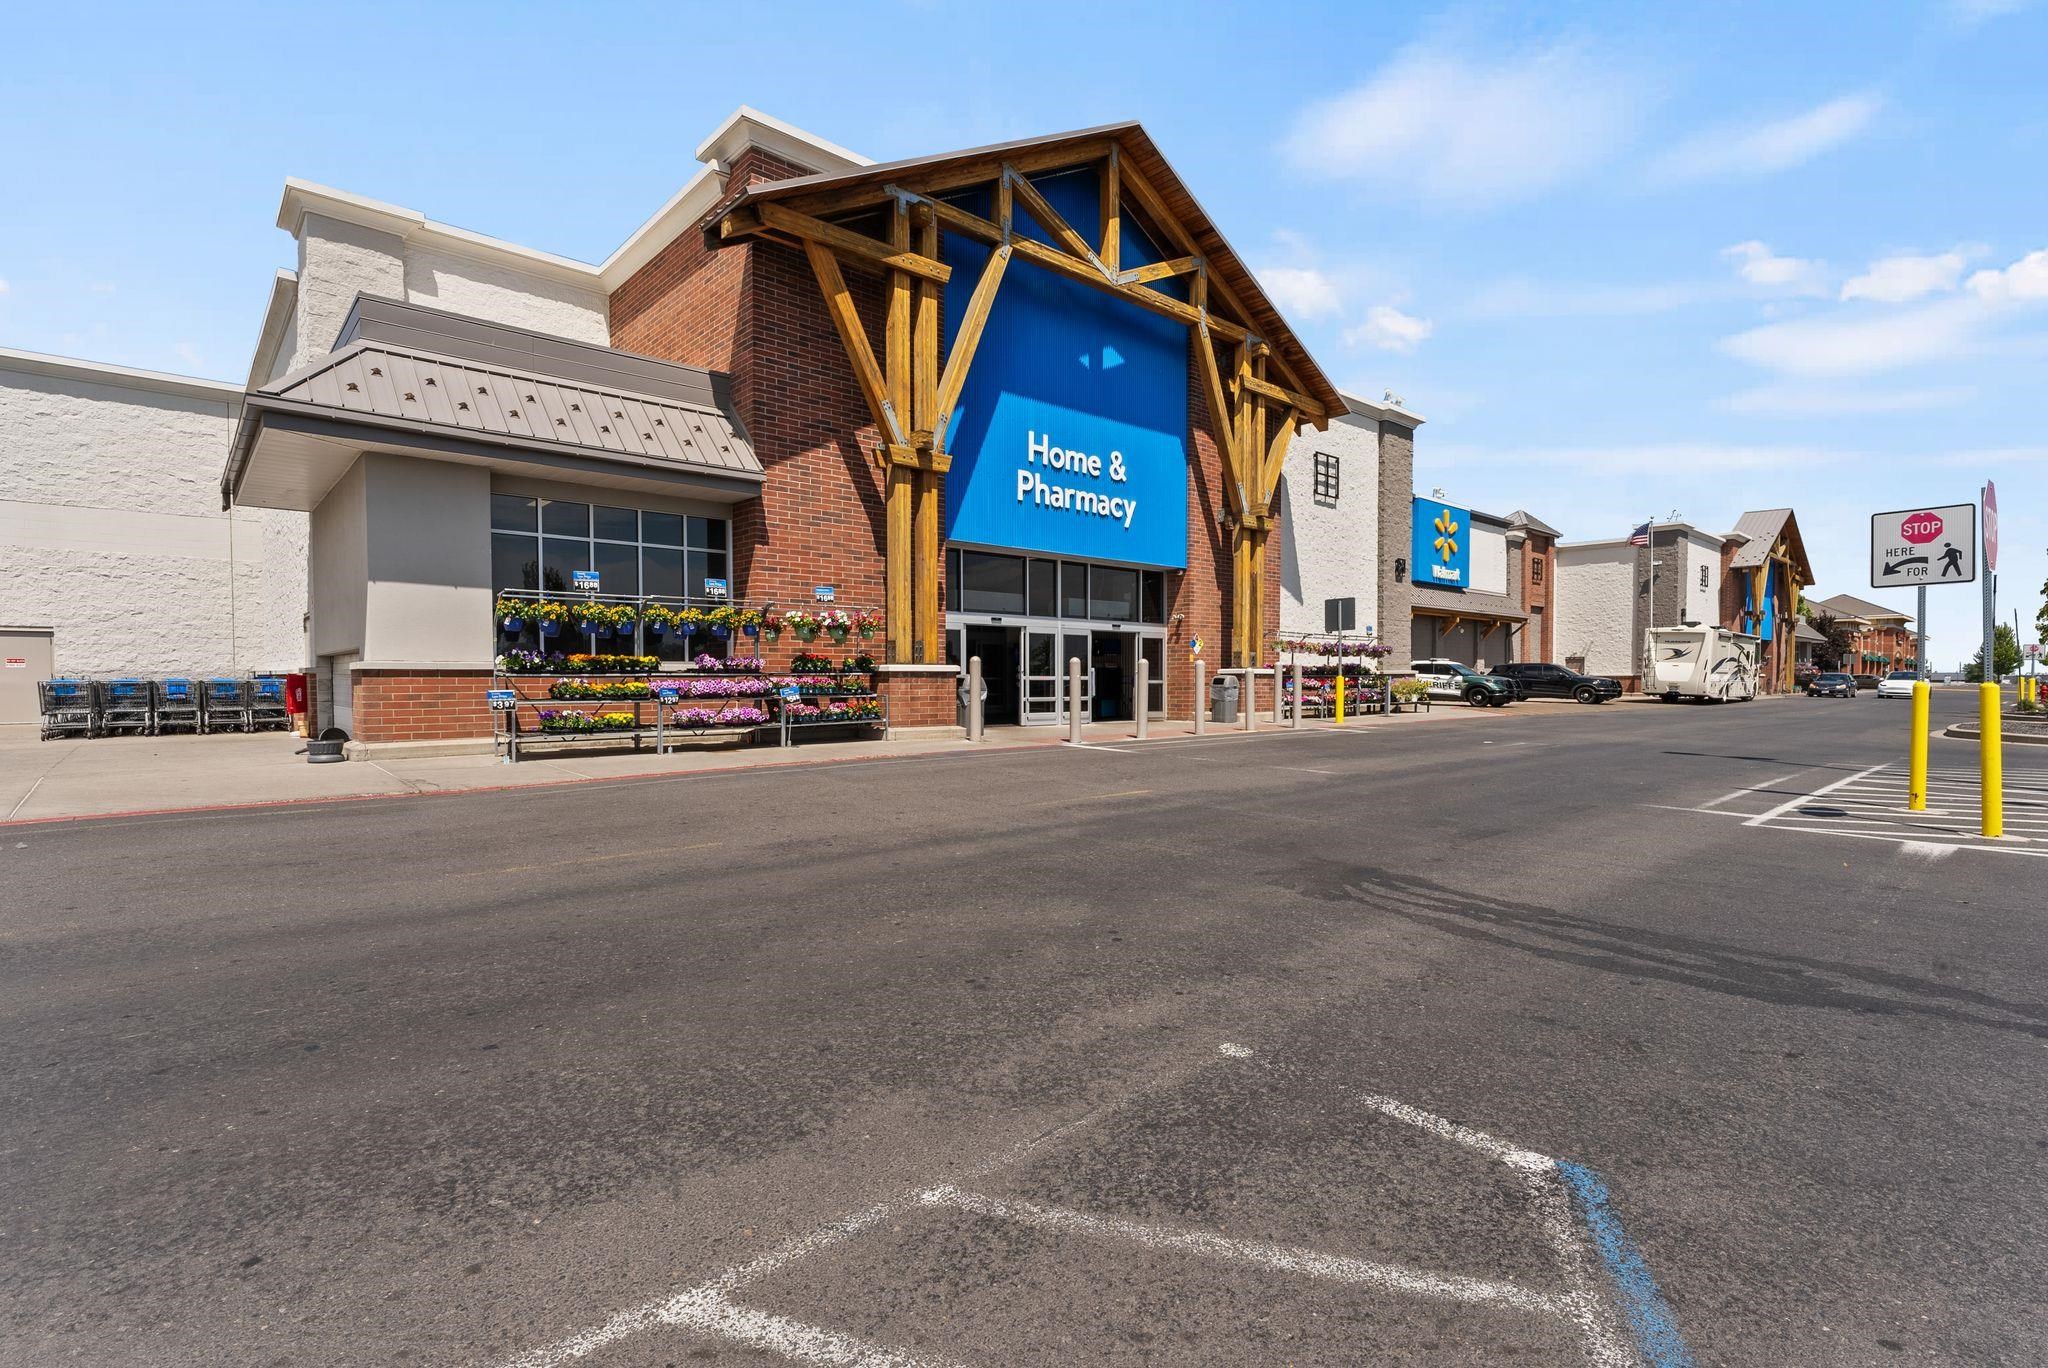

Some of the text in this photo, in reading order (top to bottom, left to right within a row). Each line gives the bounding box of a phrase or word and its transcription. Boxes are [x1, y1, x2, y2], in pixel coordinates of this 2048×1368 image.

[1028, 430, 1127, 482] Home &
[1017, 469, 1136, 528] Pharmacy
[1903, 521, 1941, 536] STOP
[1886, 546, 1915, 557] HERE
[1907, 566, 1928, 576] FOR
